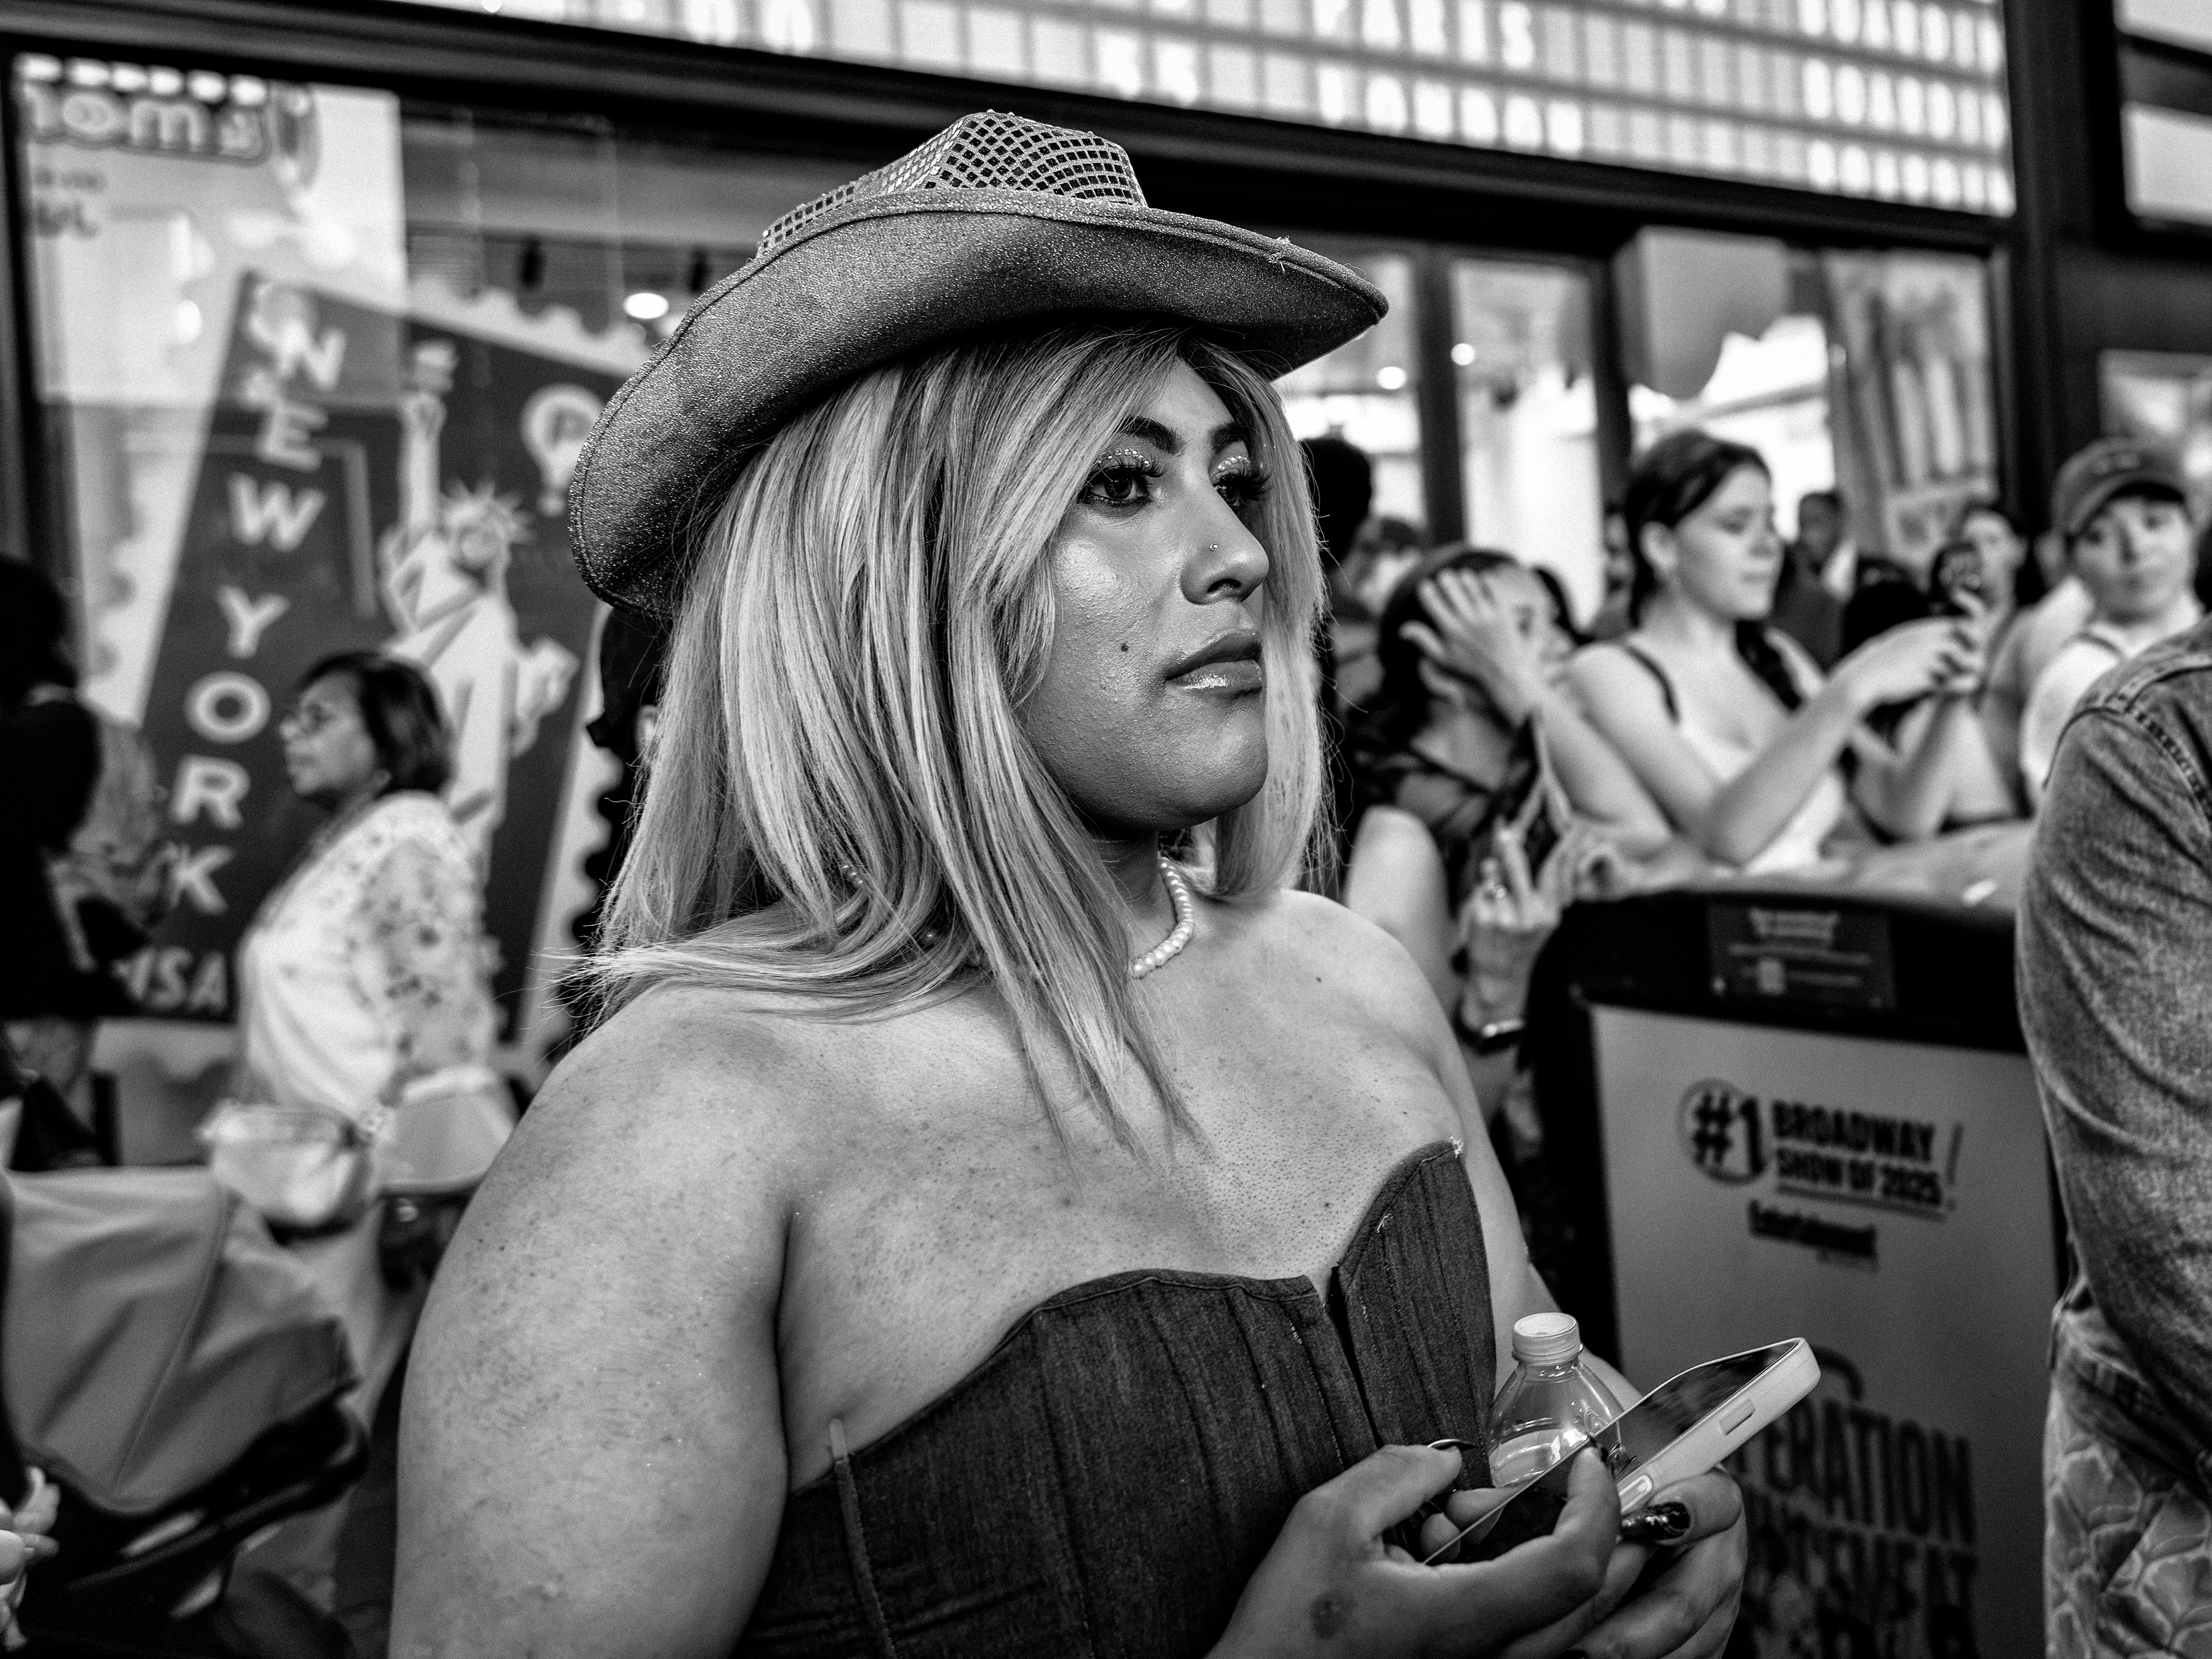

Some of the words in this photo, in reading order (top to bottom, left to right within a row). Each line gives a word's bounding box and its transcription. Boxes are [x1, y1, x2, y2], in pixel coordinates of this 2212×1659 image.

[1691, 1090, 1765, 1175] #1
[1771, 1099, 1936, 1164] BROADWAY
[1776, 1146, 1843, 1187] SHOW
[1724, 1396, 1976, 1547] ERATION
